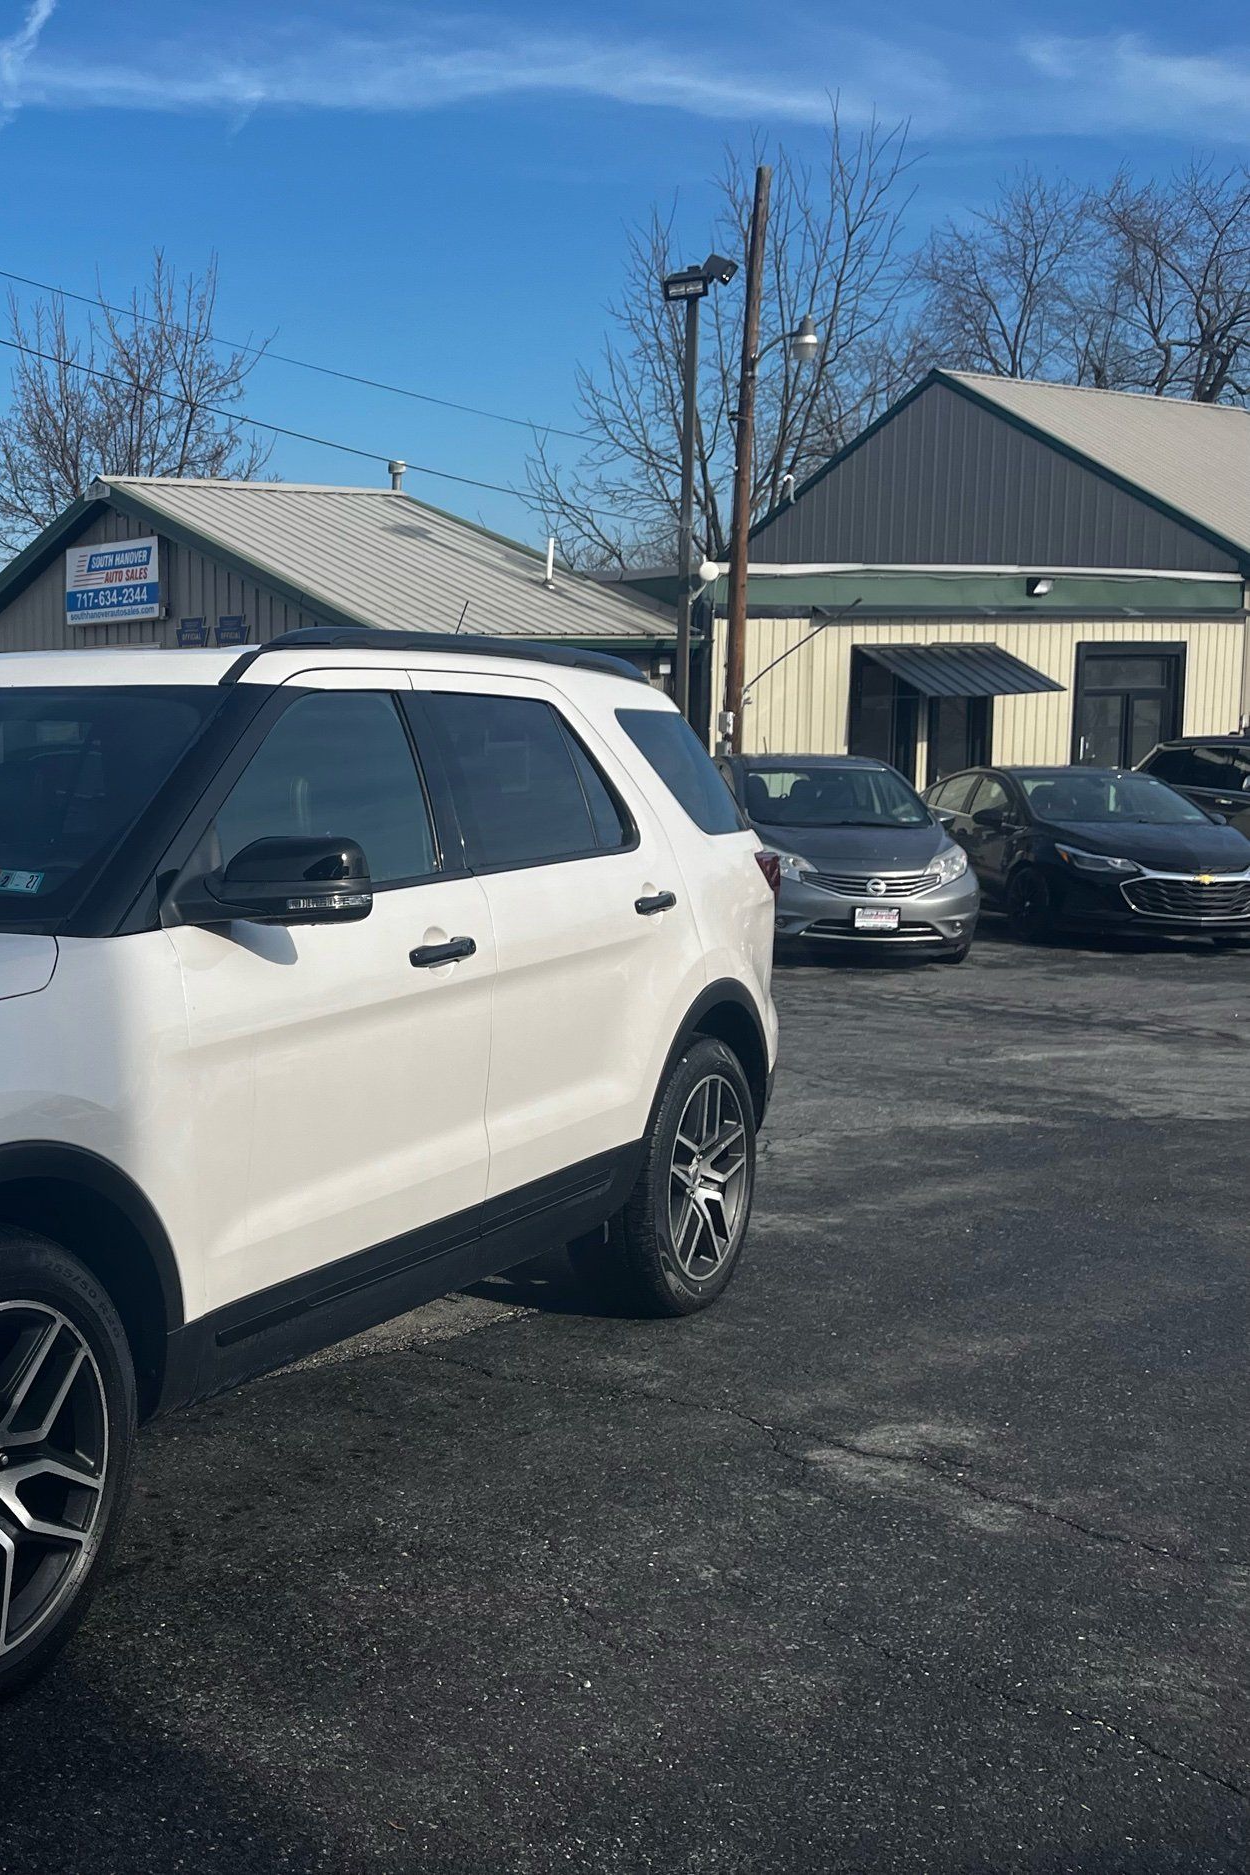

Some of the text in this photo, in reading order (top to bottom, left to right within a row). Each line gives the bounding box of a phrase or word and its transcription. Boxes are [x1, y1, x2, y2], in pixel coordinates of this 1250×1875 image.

[91, 550, 148, 569] SOUTH HANOVER
[104, 566, 148, 584] AUTO SALES
[76, 586, 148, 609] 717-634-2344
[70, 605, 155, 621] southhanoverautosales.com
[26, 875, 39, 890] 27
